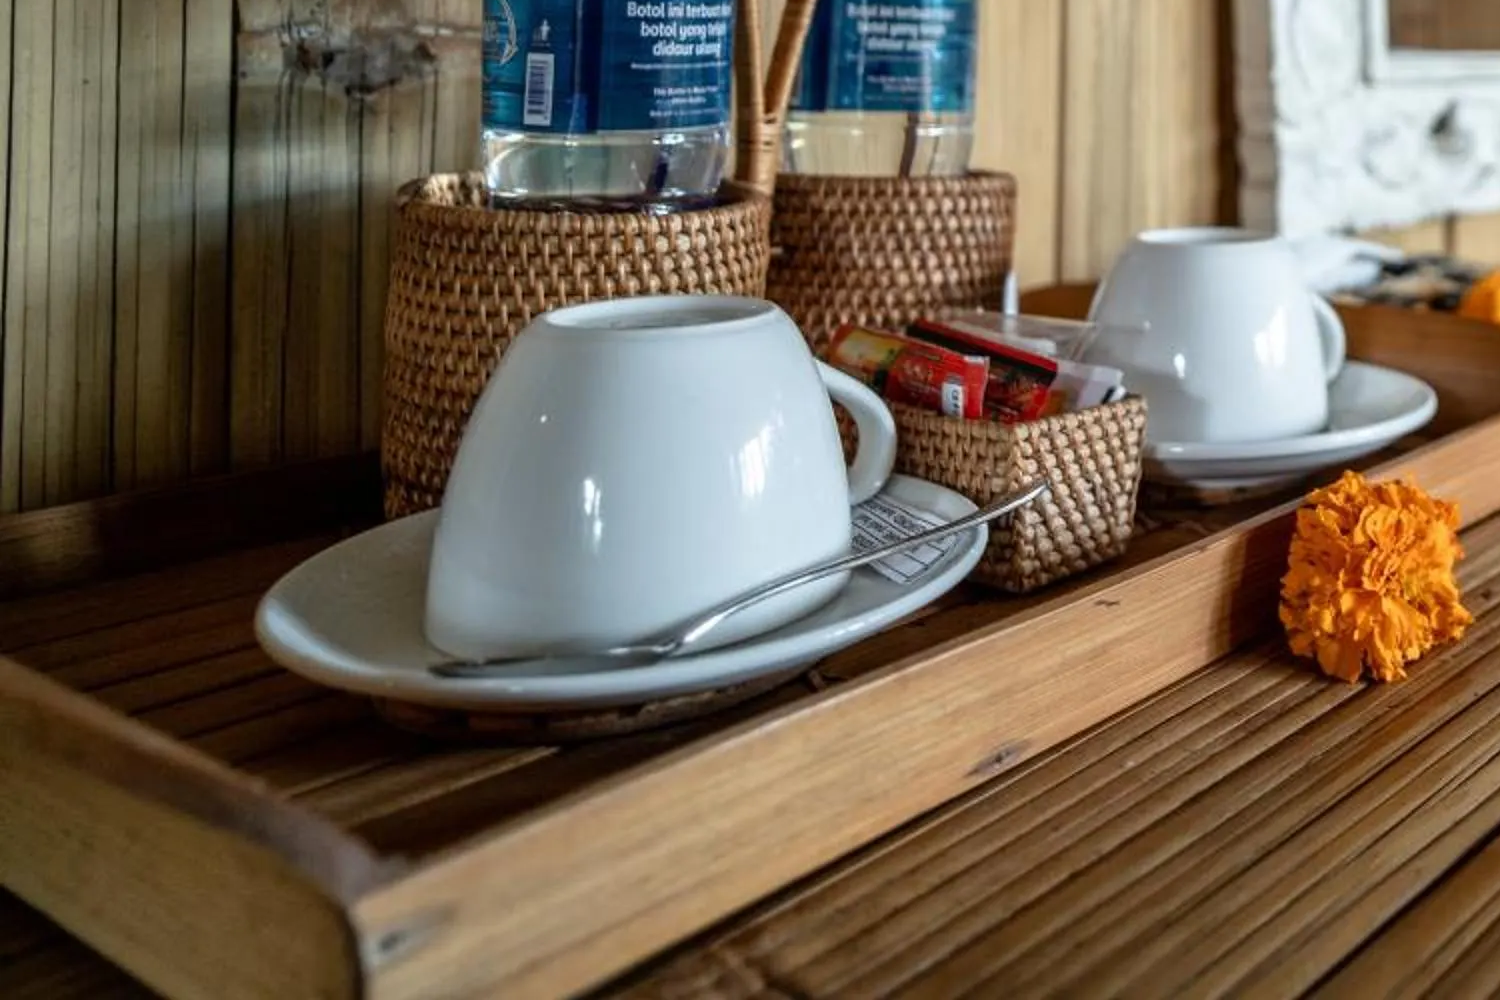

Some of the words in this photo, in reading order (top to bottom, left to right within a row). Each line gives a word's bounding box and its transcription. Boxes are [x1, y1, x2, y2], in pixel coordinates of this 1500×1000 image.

[627, 1, 665, 18] Botol
[667, 1, 684, 18] ini
[640, 21, 677, 37] botol
[680, 24, 707, 42] yang
[653, 40, 694, 56] didaur
